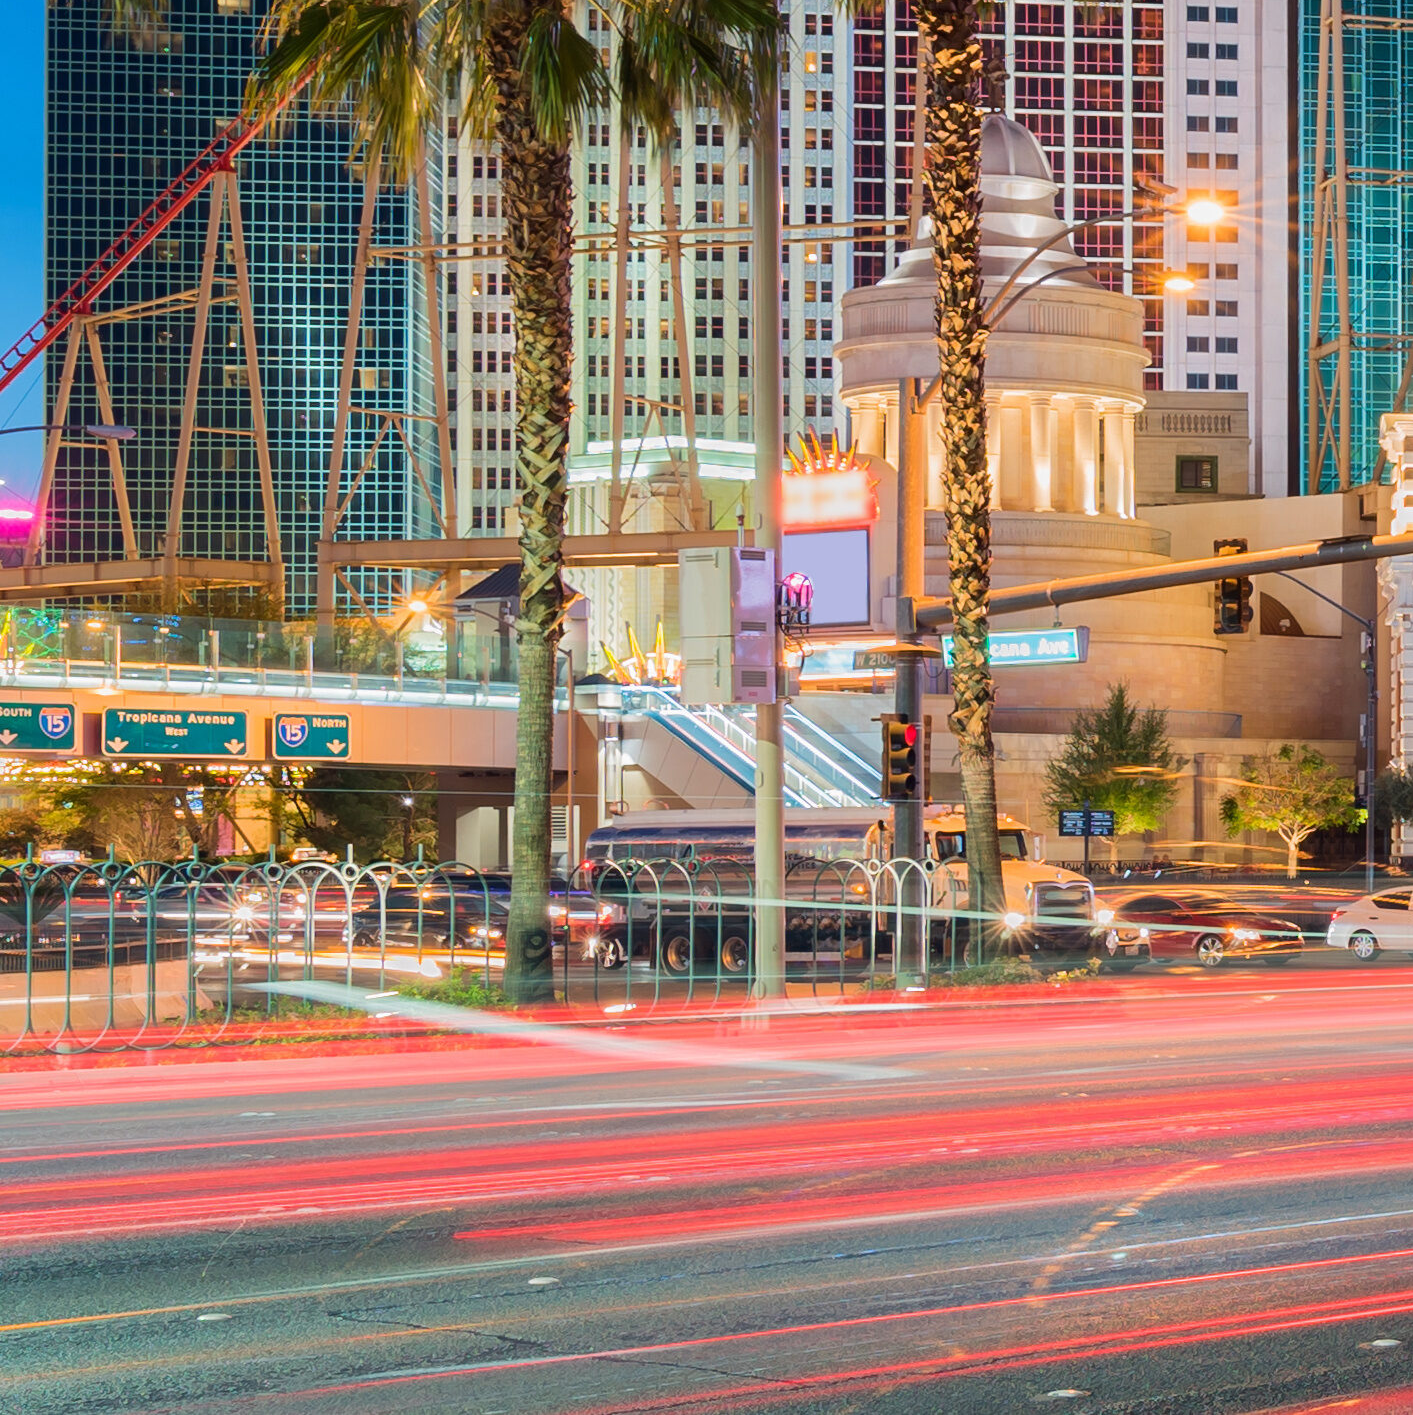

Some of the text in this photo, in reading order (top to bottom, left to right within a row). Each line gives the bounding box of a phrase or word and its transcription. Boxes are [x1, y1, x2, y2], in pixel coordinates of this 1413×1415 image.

[1037, 637, 1069, 655] Ave
[855, 654, 866, 666] W
[46, 714, 65, 733] 15
[117, 711, 235, 725] Tropicana Avenue
[285, 717, 347, 741] 15 NORTH
